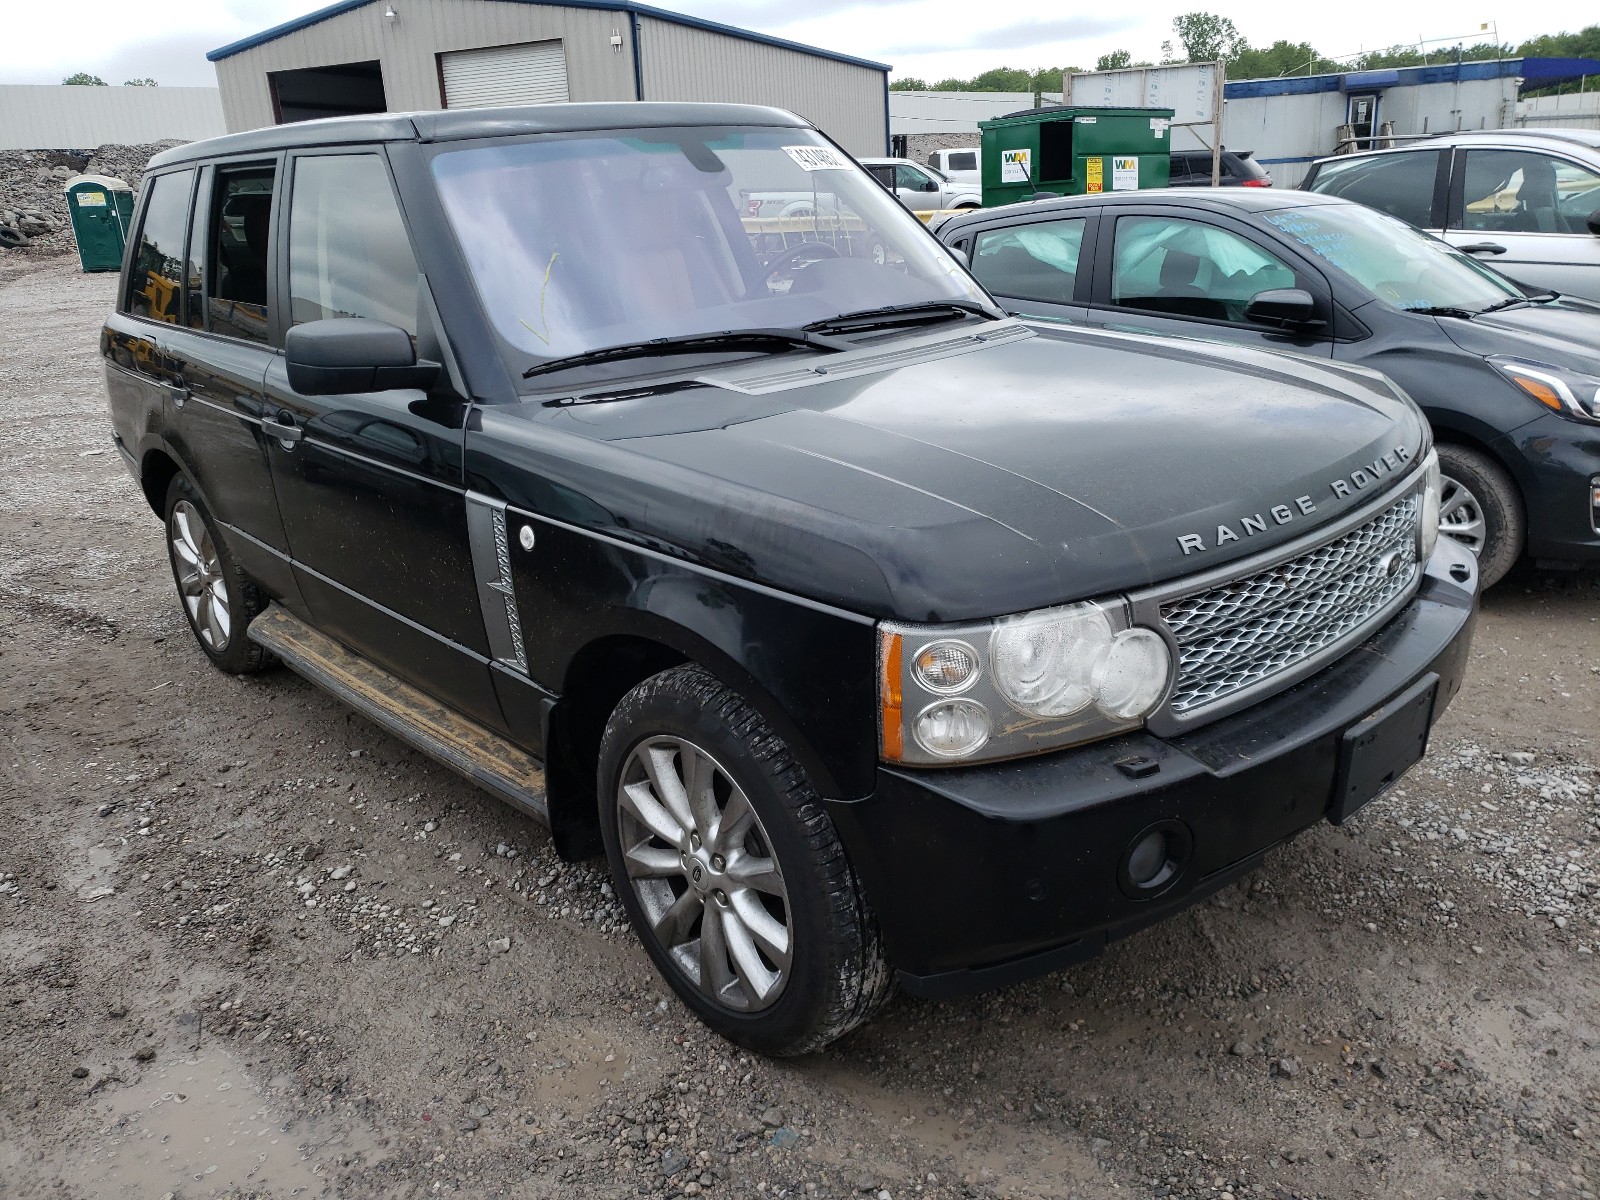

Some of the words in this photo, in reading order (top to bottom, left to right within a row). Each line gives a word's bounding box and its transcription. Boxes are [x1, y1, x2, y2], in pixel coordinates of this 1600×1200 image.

[1004, 152, 1028, 163] WM
[1115, 159, 1136, 170] WM
[1176, 495, 1317, 555] RANGE
[1329, 444, 1410, 499] ROVER
